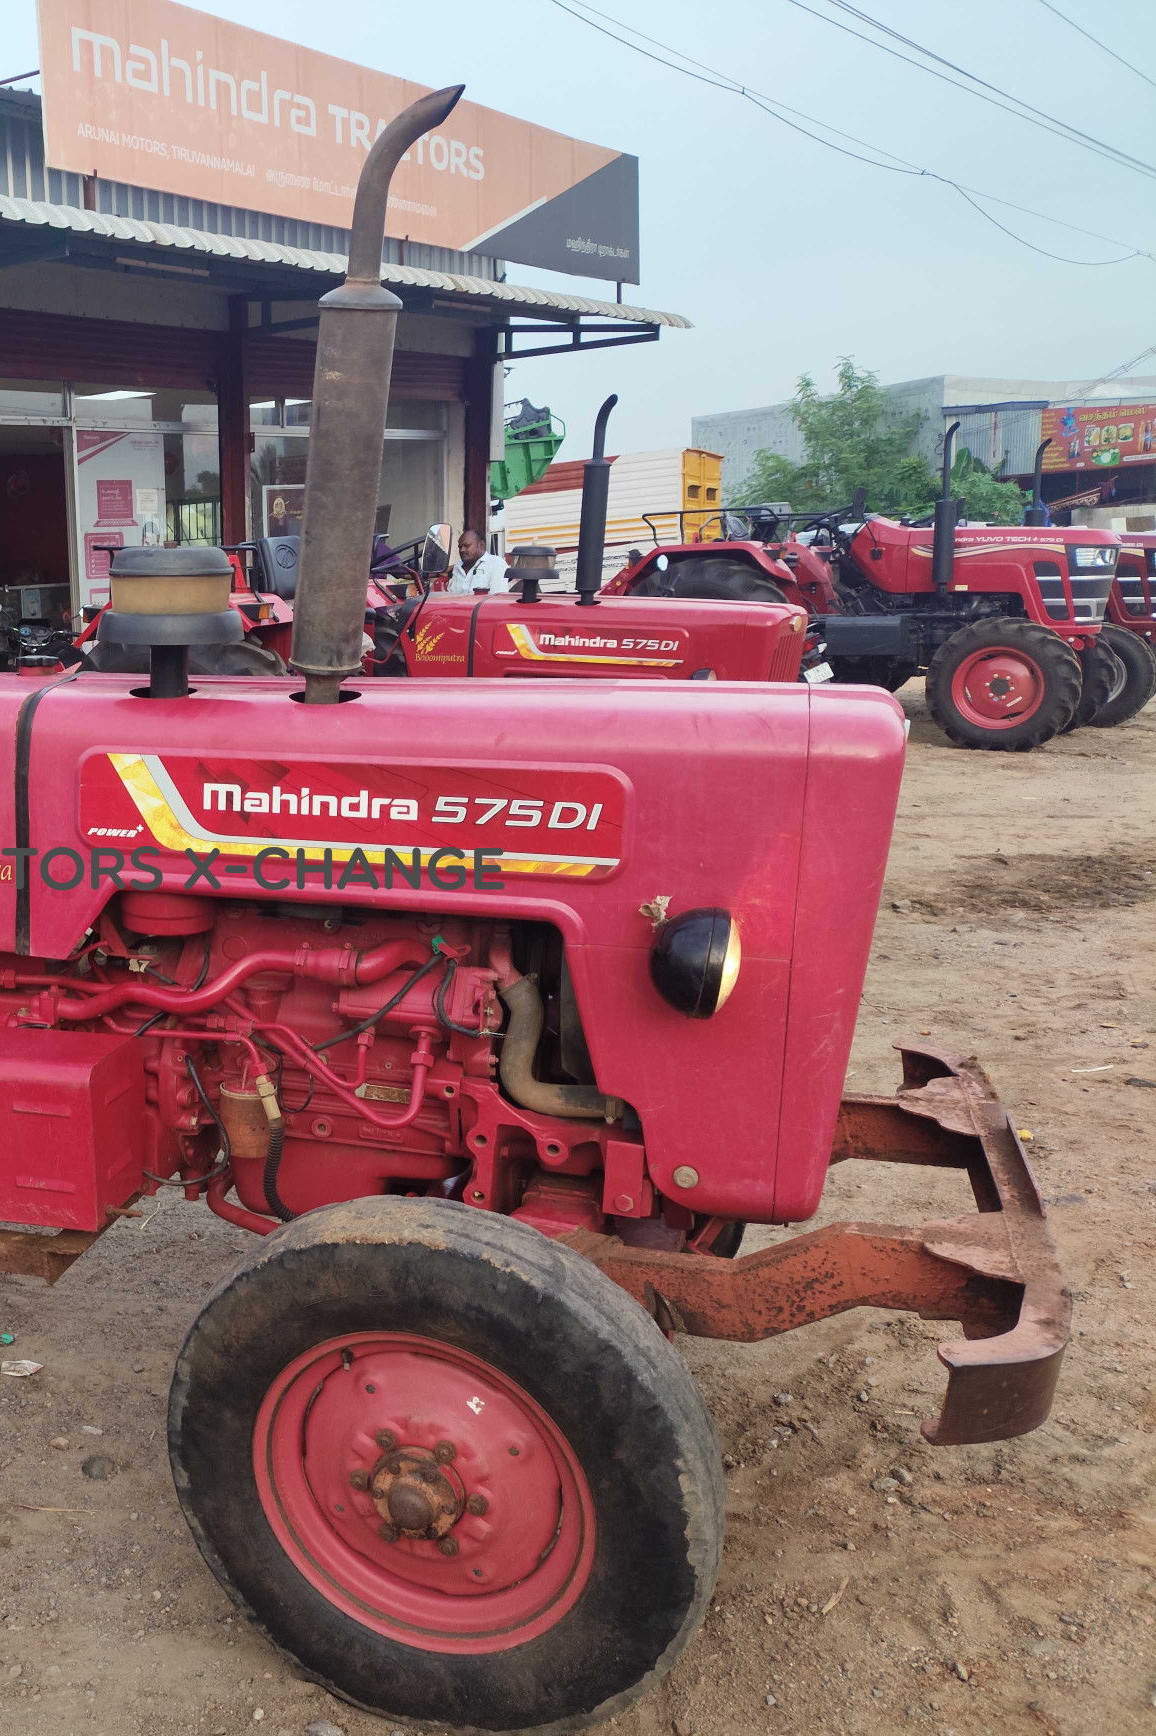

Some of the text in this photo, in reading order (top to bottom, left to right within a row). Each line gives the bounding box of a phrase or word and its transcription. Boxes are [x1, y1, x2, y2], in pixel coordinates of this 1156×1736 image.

[77, 122, 255, 177] ARUNAI MOTORS, TIRUVANNAMALAI
[328, 103, 485, 181] TRTORS
[415, 653, 465, 664] Bhoomiputra
